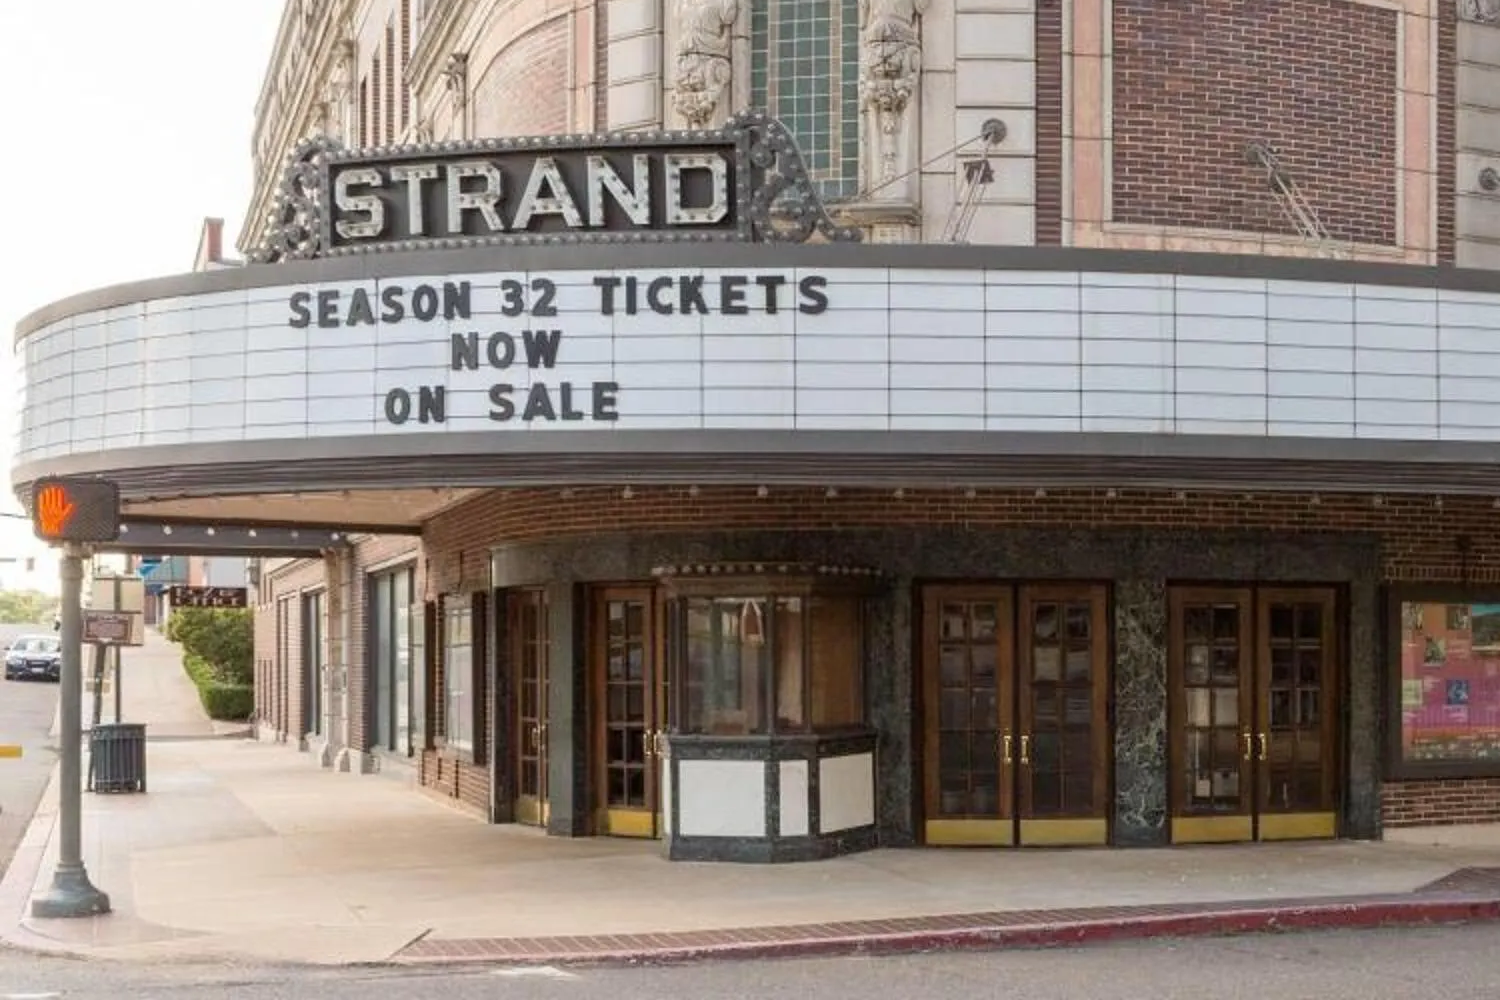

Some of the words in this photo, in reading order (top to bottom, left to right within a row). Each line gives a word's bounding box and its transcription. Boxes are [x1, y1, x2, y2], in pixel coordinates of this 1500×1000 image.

[333, 153, 730, 240] STRAND
[288, 280, 472, 328] SEASON
[499, 278, 559, 317] 32
[593, 274, 830, 315] TICKETS
[450, 329, 562, 371] NOW
[384, 384, 446, 425] ON
[488, 381, 621, 422] SALE
